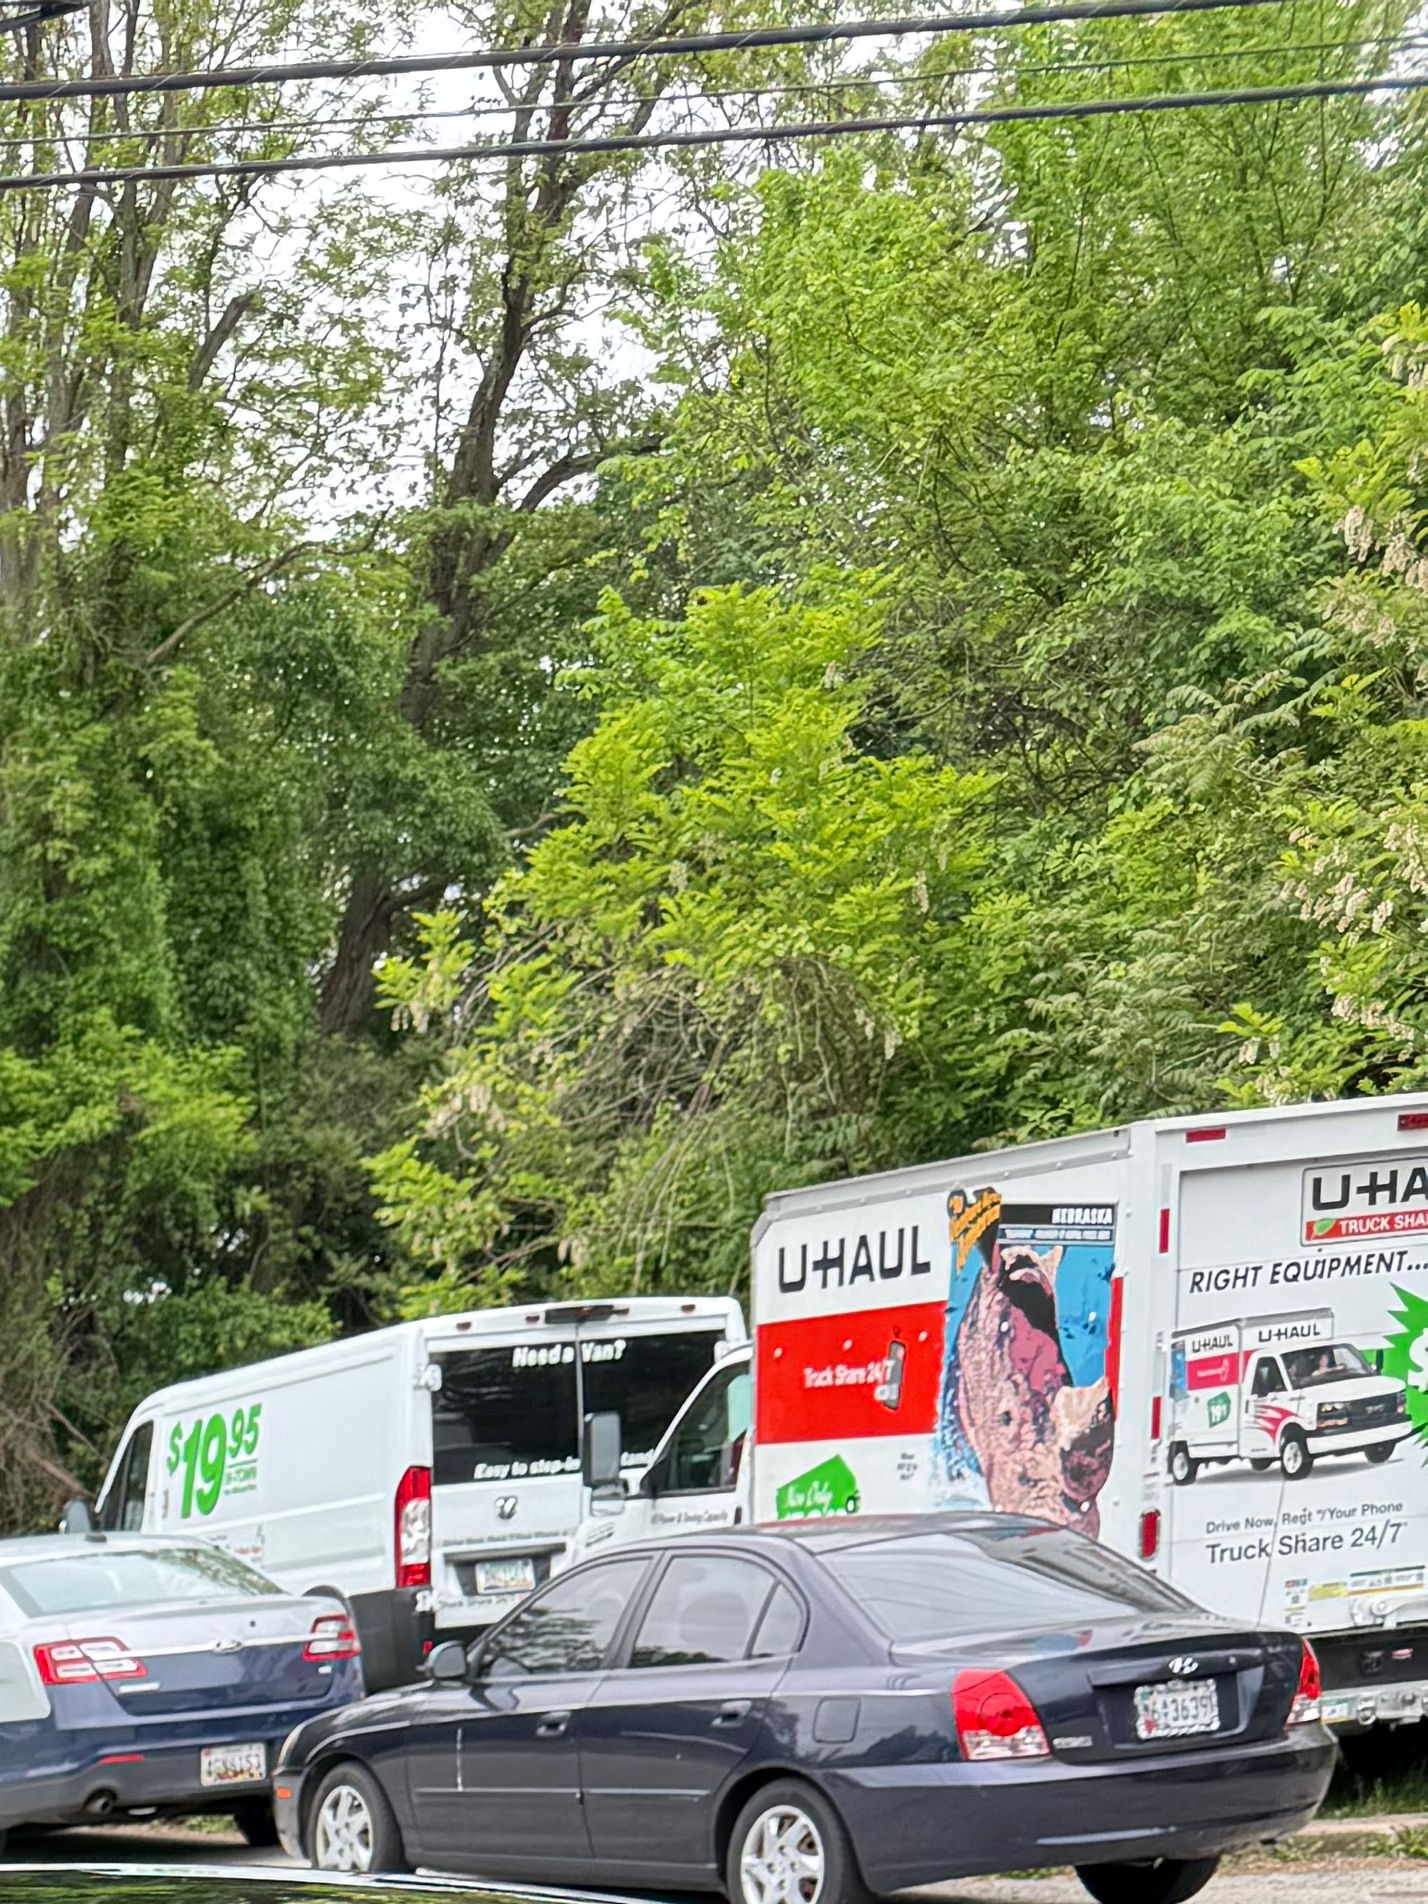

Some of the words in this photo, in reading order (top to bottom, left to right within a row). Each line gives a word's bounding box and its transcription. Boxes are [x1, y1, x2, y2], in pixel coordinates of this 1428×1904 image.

[1339, 1215, 1391, 1235] TRUCK
[1189, 1266, 1263, 1294] RIGHT
[512, 1344, 562, 1368] Need
[581, 1339, 627, 1363] Van?
[1206, 1520, 1240, 1534] Drive
[1361, 1502, 1404, 1517] Phone
[1206, 1538, 1271, 1564] Truck
[1278, 1532, 1344, 1556] Share
[1350, 1519, 1404, 1550] 24/7
